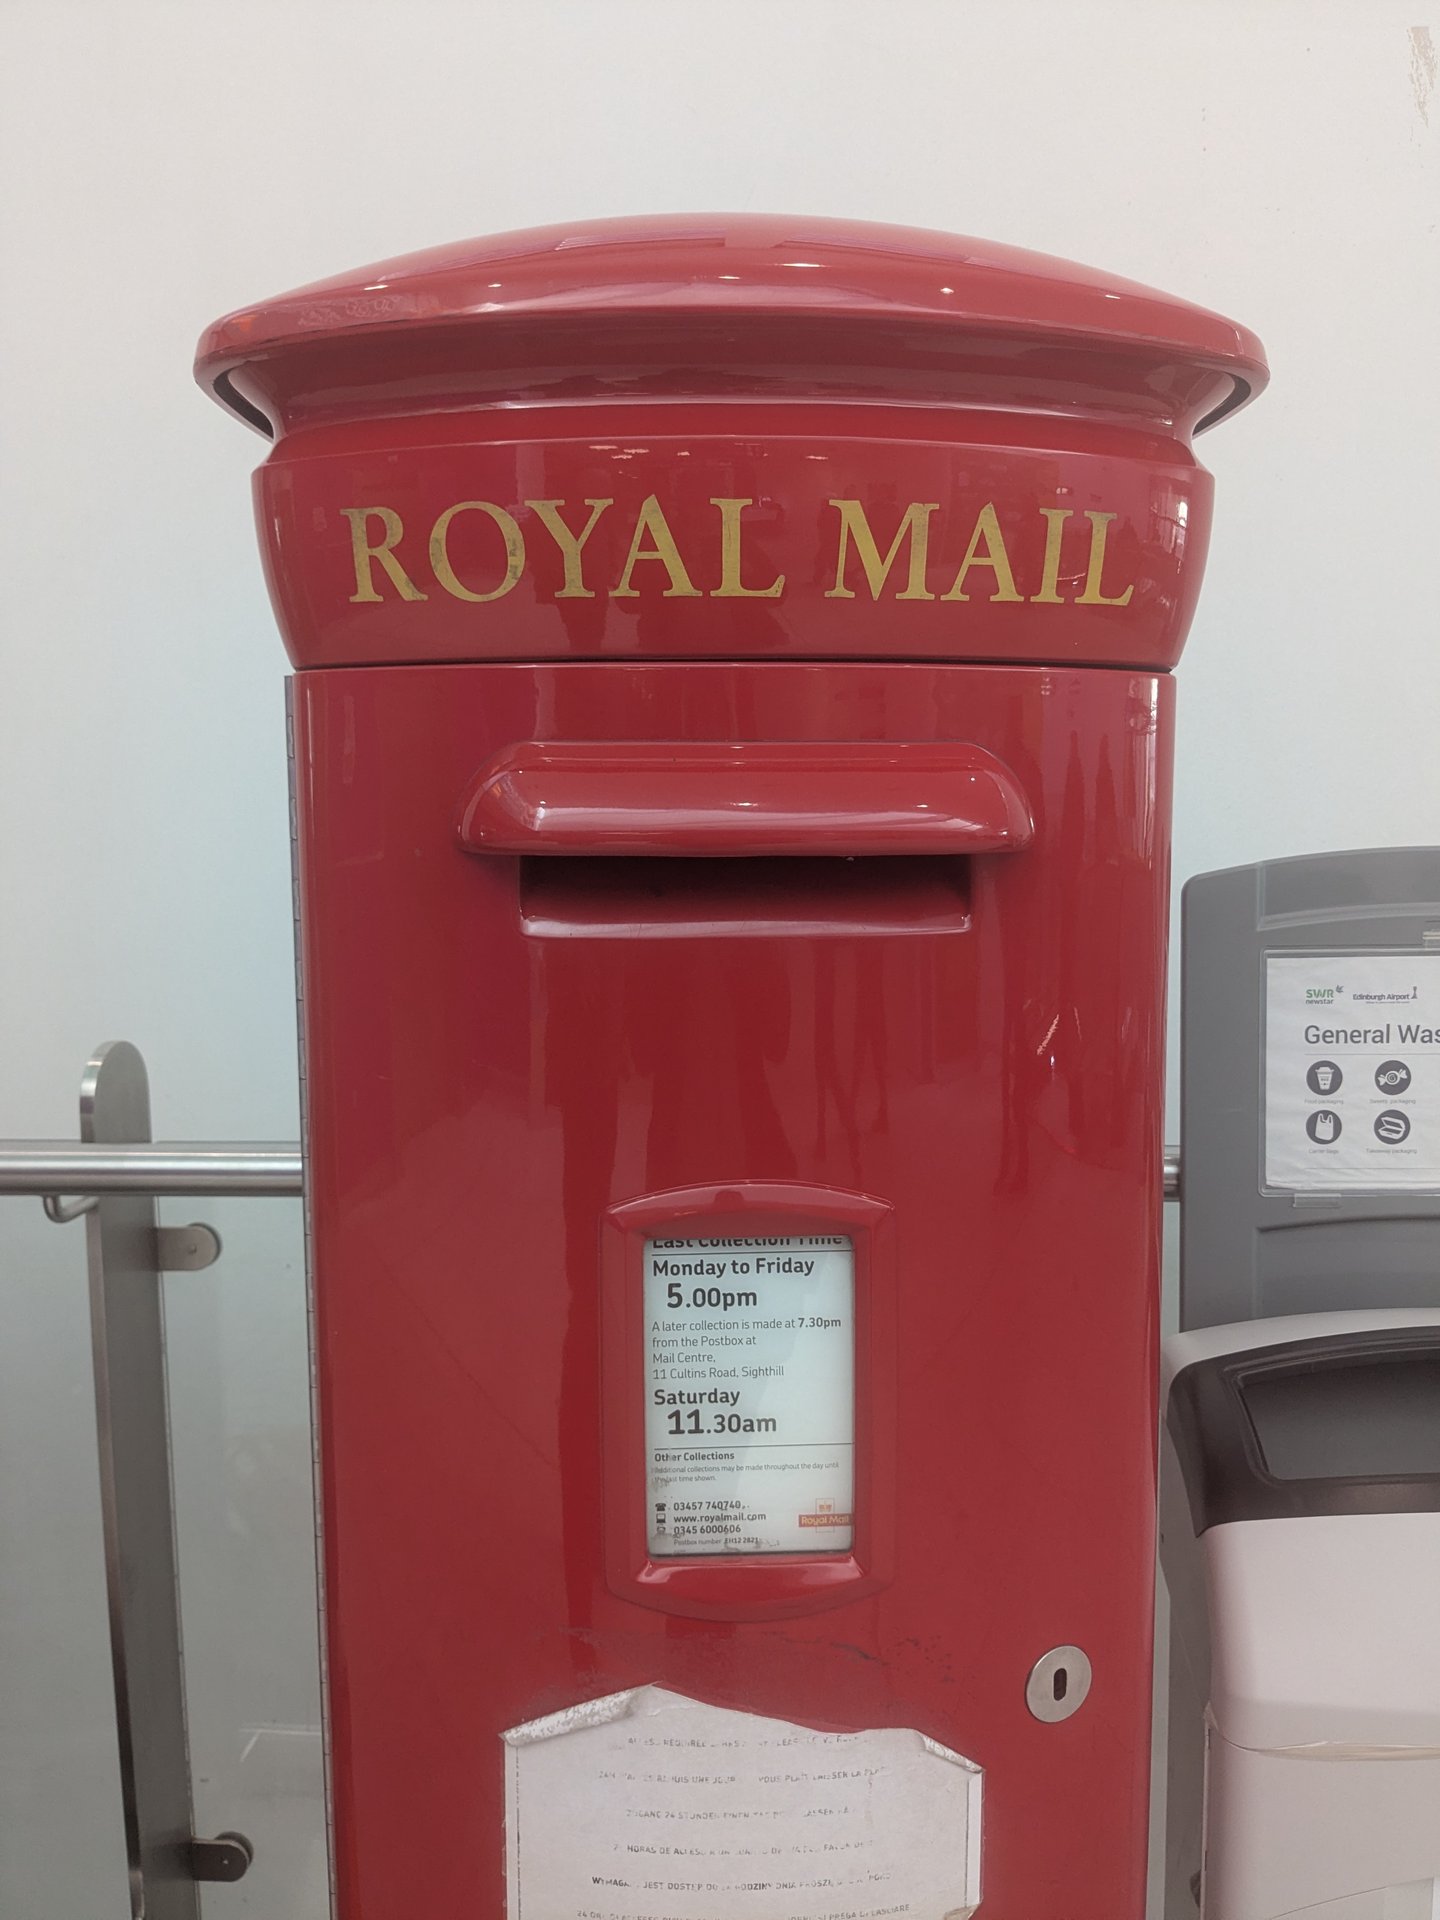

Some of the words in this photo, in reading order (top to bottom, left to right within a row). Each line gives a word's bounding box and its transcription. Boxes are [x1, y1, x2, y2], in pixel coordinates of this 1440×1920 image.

[339, 493, 786, 603] ROYAL
[824, 497, 1135, 606] MAIL
[1305, 989, 1335, 998] SWR
[1353, 993, 1386, 1001] Edinburgh
[1387, 993, 1410, 1001] Airport
[1304, 1023, 1391, 1044] General
[653, 1259, 727, 1278] Monday
[731, 1260, 750, 1274] to
[756, 1257, 815, 1276] Friday
[667, 1283, 758, 1311] 5.00pm
[652, 1321, 660, 1332] A
[662, 1320, 687, 1332] later
[689, 1319, 739, 1331] collection
[742, 1319, 750, 1330] is
[752, 1318, 782, 1329] made
[785, 1319, 796, 1328] at
[798, 1316, 842, 1330] 7.30pm
[652, 1336, 679, 1348] from
[681, 1336, 698, 1347] the
[701, 1335, 743, 1347] Postbox
[745, 1336, 756, 1345] at
[653, 1352, 675, 1364] Mail
[677, 1352, 716, 1364] Centre,
[652, 1368, 667, 1379] 11
[670, 1367, 707, 1379] Cultins
[709, 1367, 739, 1379] Road,
[741, 1365, 784, 1379] Sighthill
[654, 1388, 740, 1407] Saturday
[667, 1409, 777, 1435] 11.30am
[654, 1452, 681, 1462] Other
[683, 1451, 735, 1461] Collections
[764, 1463, 800, 1471] throughout
[812, 1462, 823, 1470] day
[673, 1501, 703, 1511] 03457
[673, 1512, 767, 1523] www.royalmail.com
[801, 1515, 828, 1526] Royal
[829, 1515, 849, 1524] Mail
[673, 1525, 698, 1535] 0345
[700, 1524, 742, 1534] 6000606
